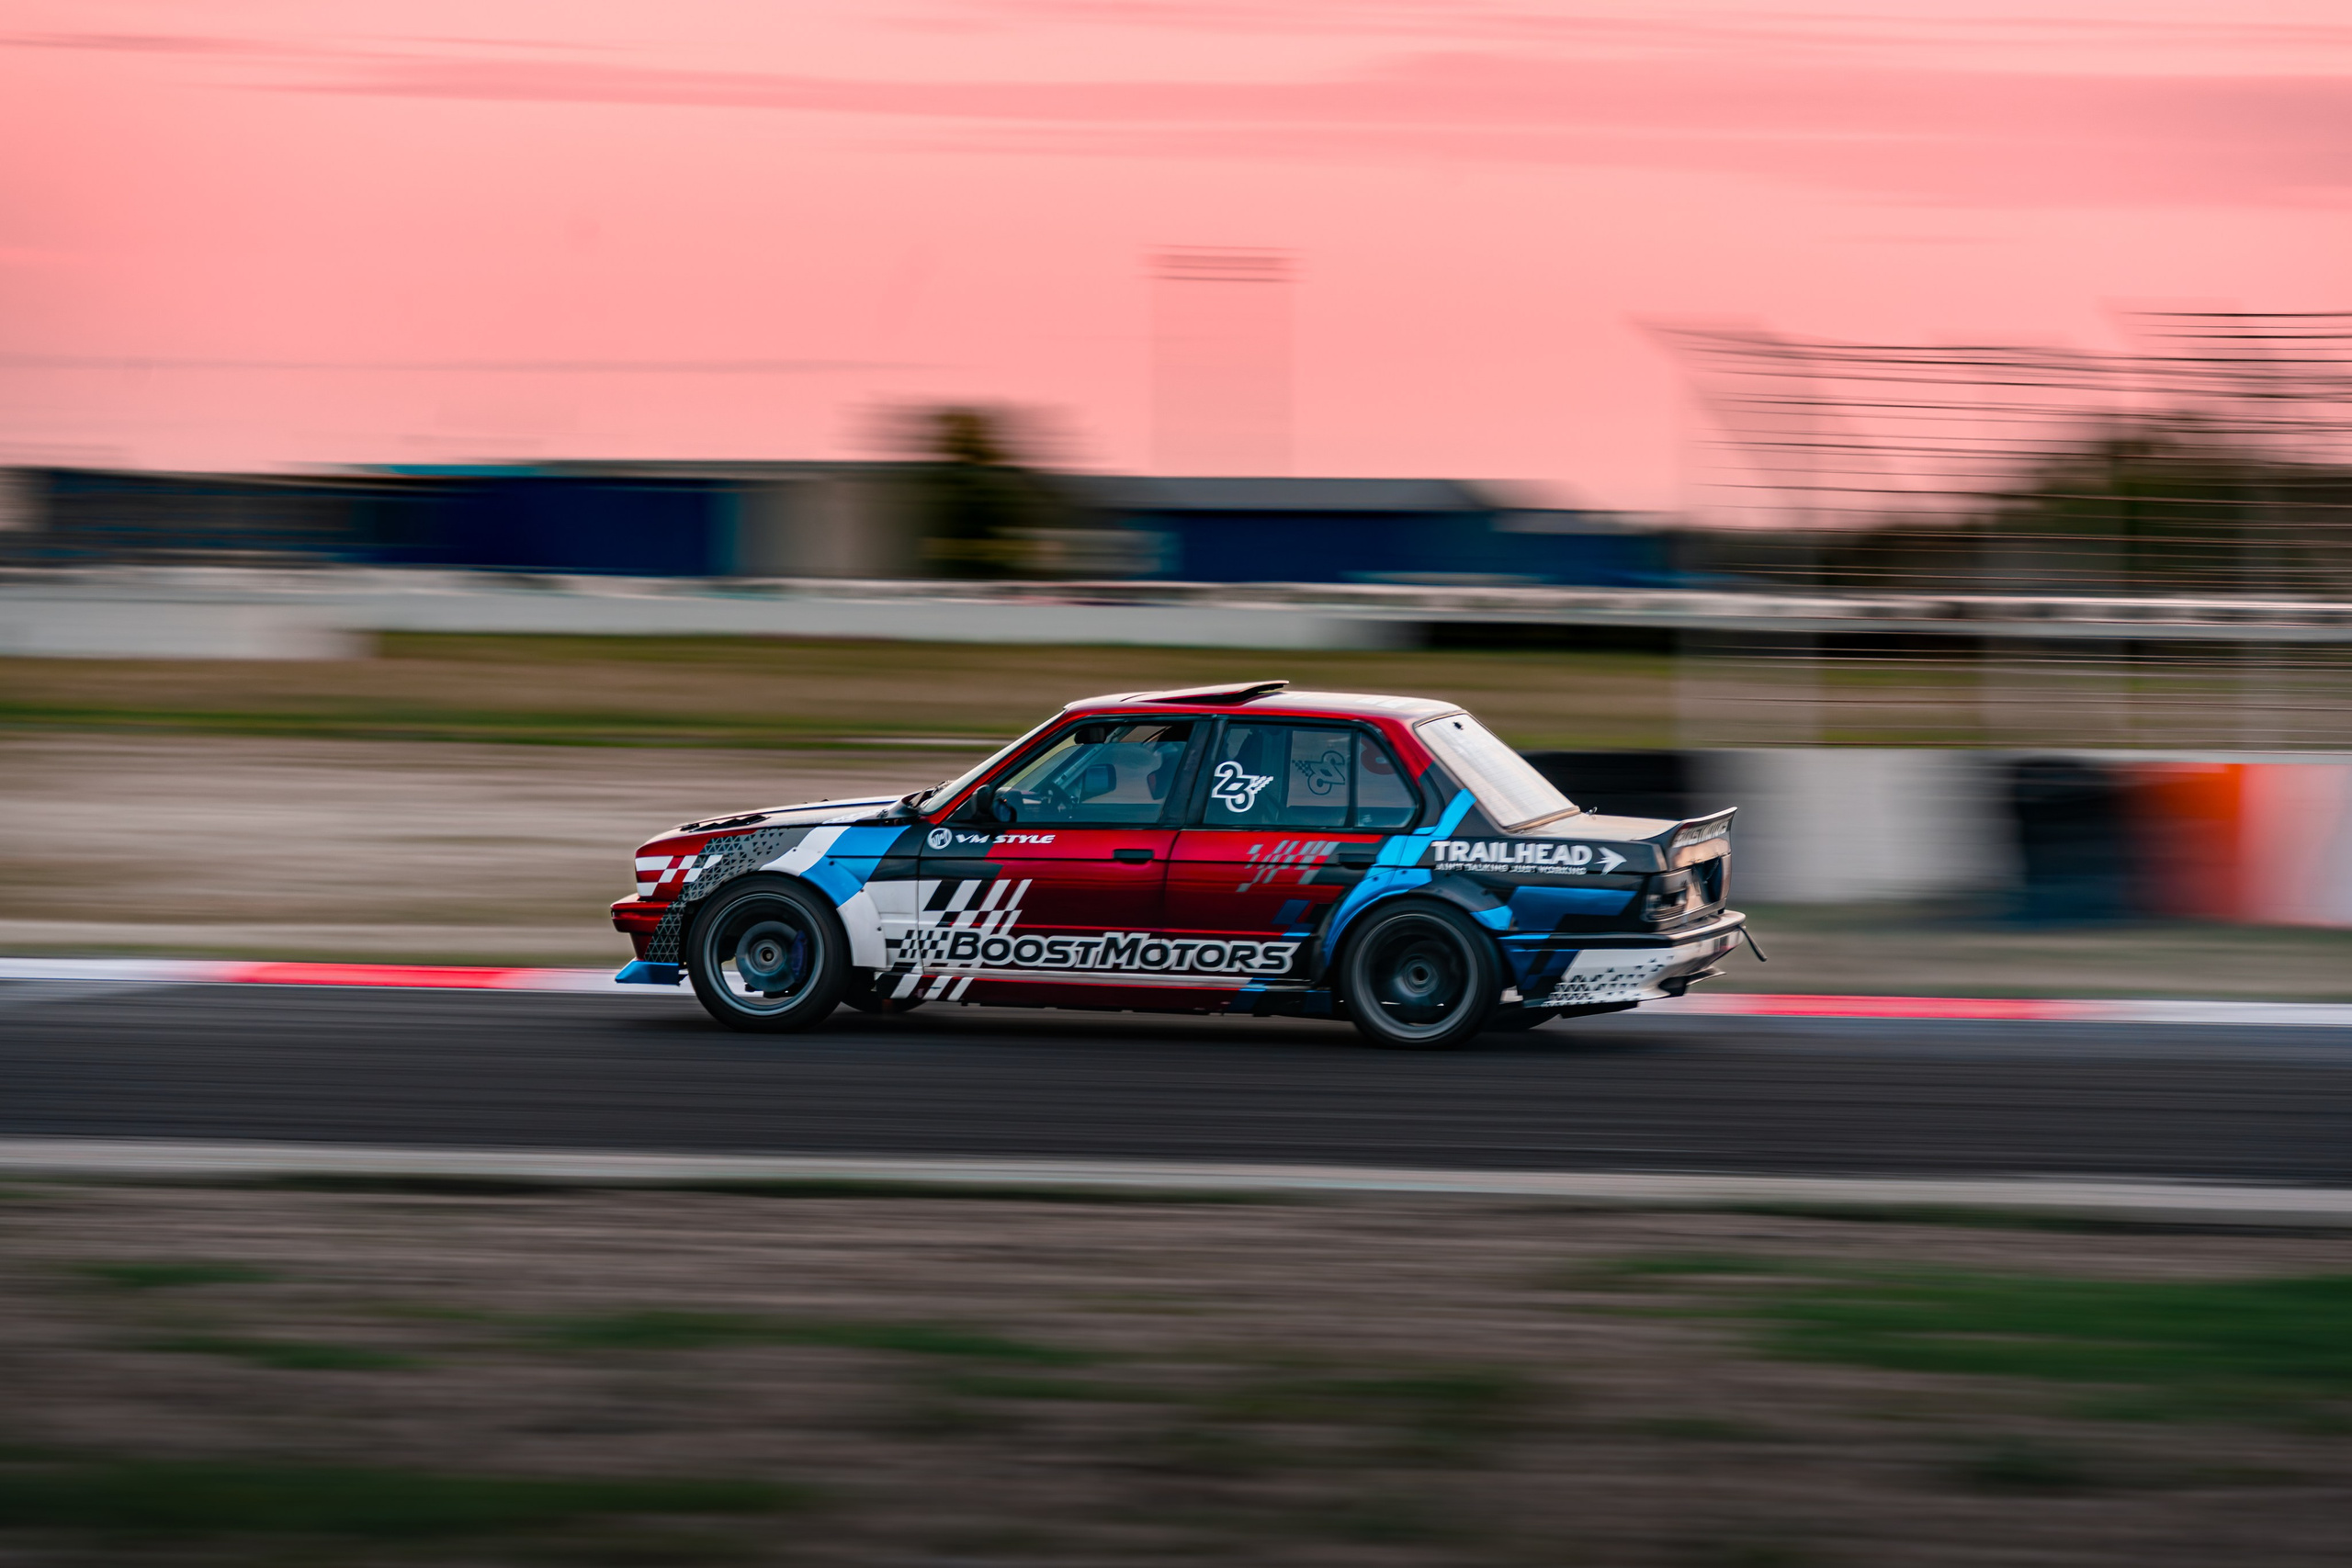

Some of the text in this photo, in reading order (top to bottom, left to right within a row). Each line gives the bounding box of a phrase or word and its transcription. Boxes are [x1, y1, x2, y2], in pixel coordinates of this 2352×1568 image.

[956, 834, 990, 844] VM
[992, 834, 1057, 844] STYLE
[1431, 840, 1593, 866] TRAILHEAD
[946, 931, 1292, 972] BOOSTMOTORS
